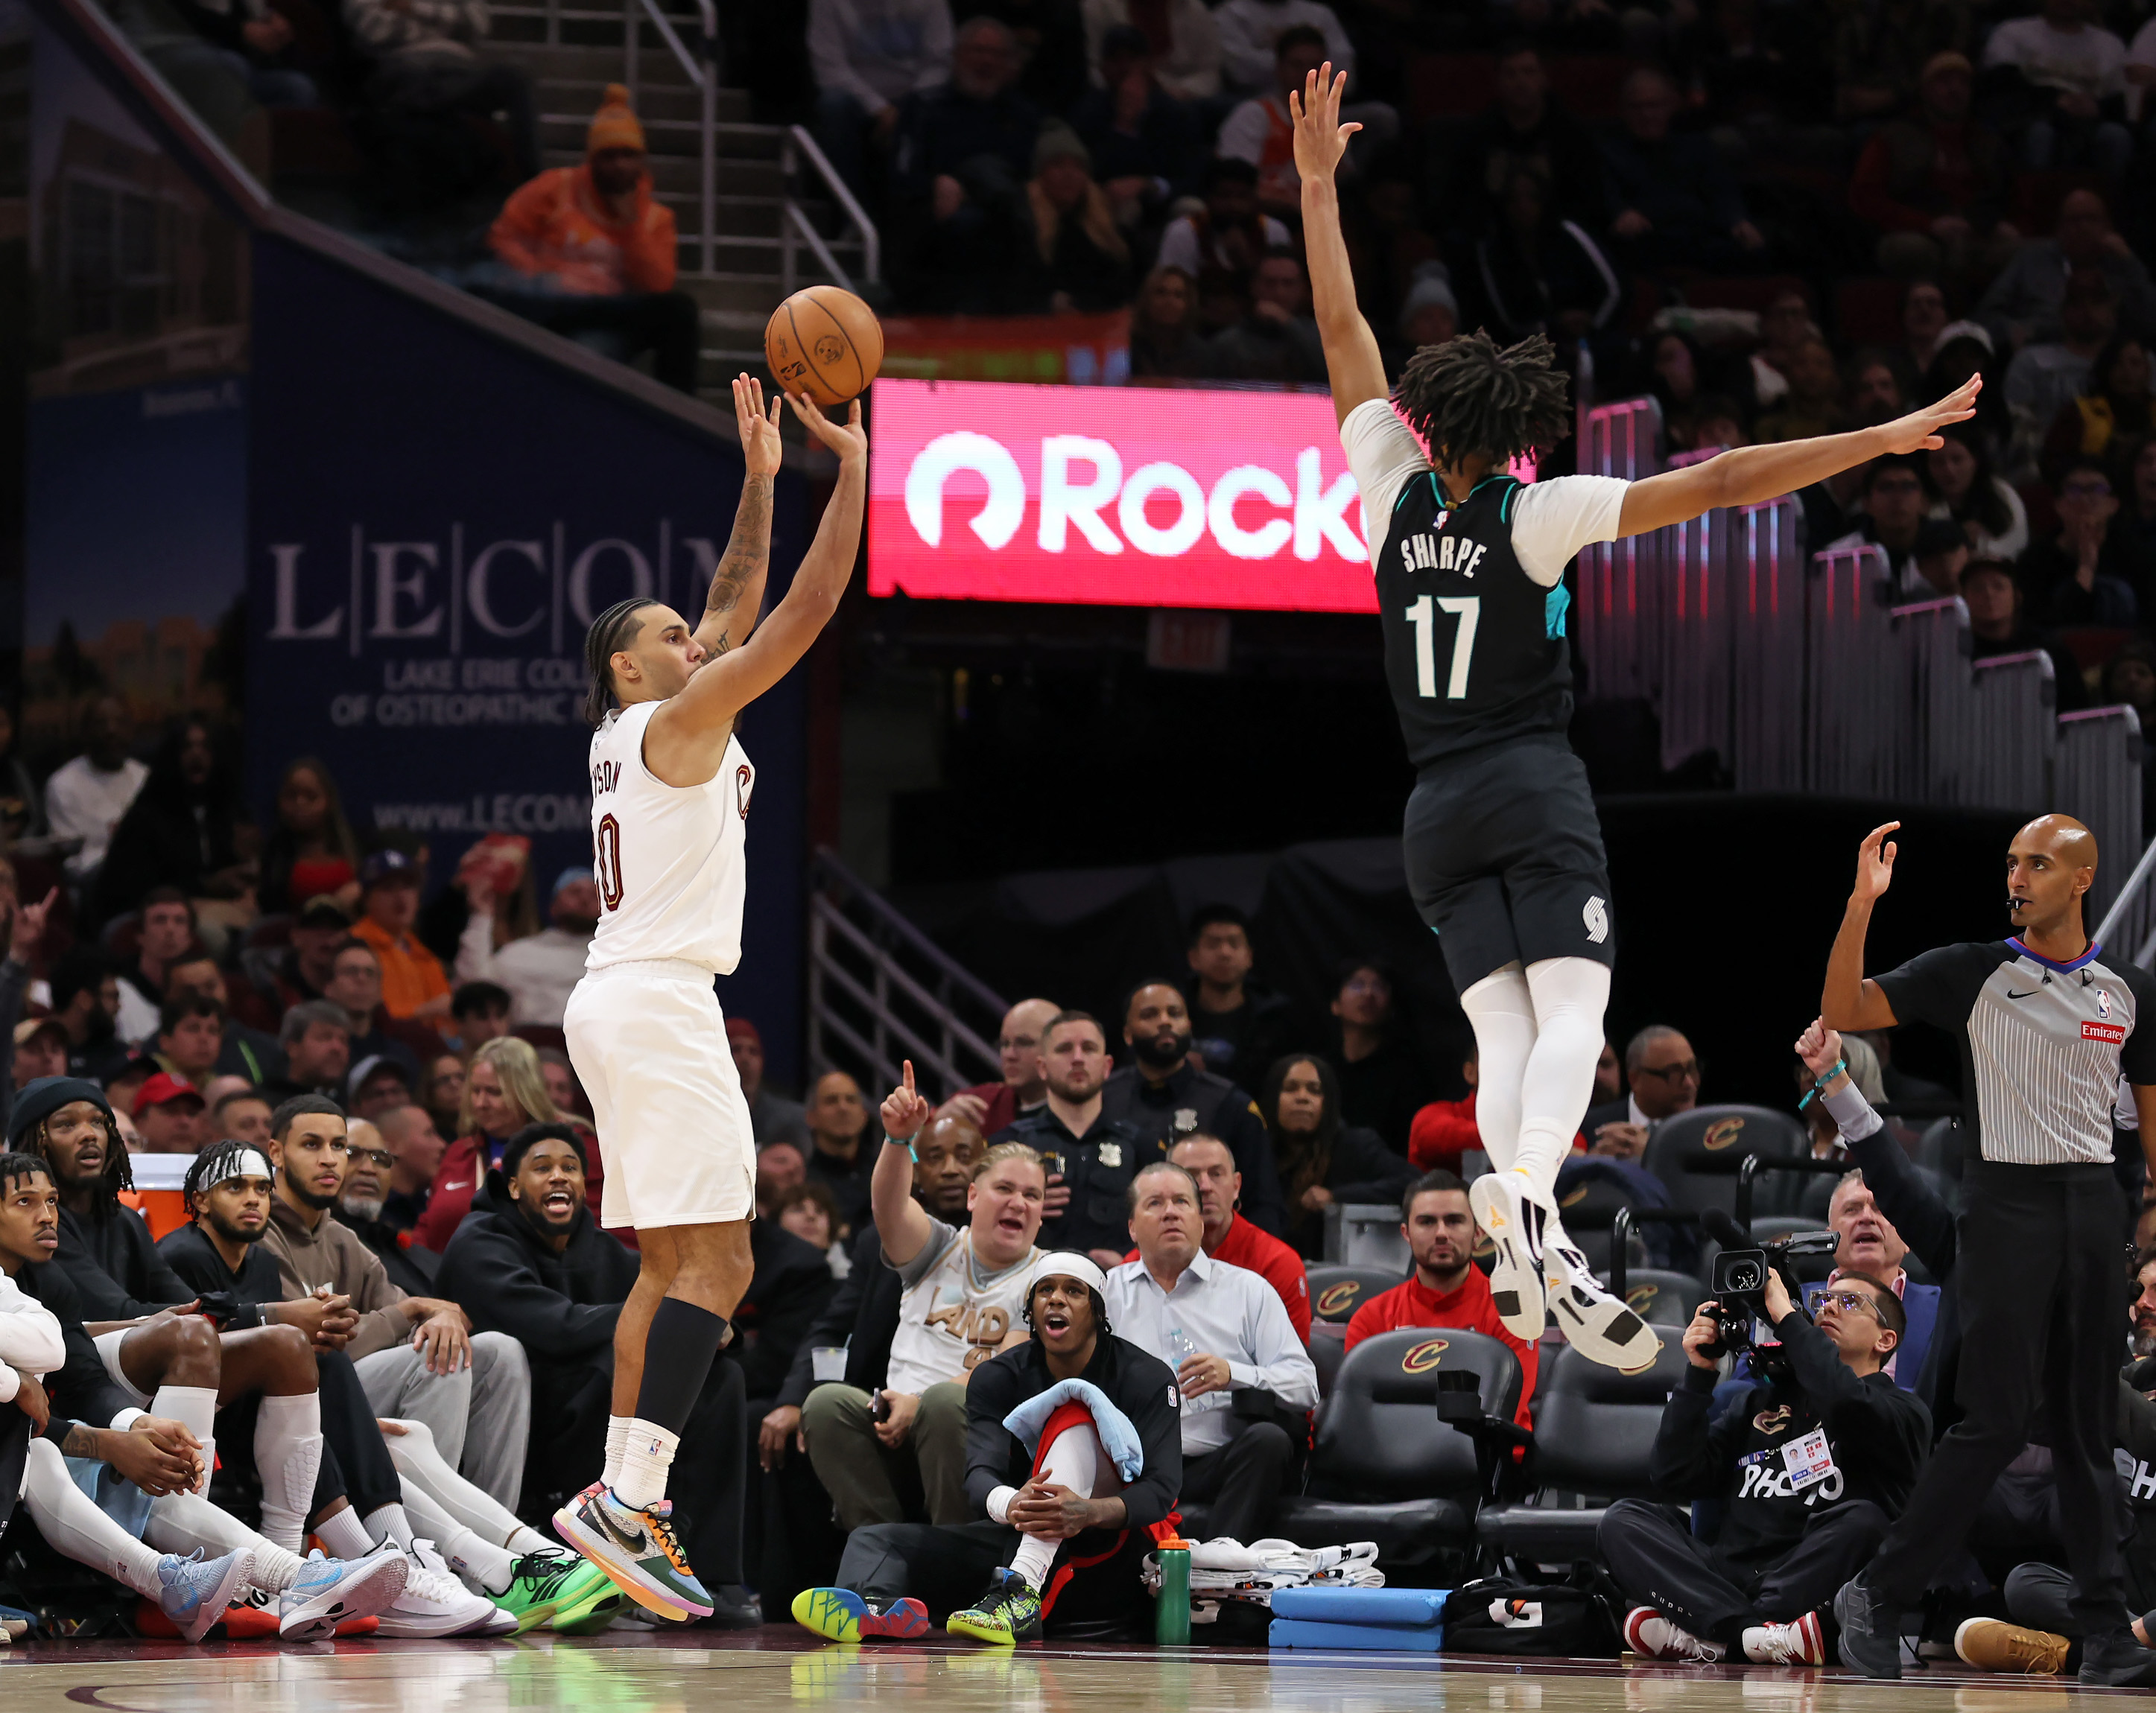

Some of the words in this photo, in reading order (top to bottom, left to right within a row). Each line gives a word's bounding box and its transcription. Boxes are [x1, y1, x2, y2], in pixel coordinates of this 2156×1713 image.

[1039, 434, 1369, 564] Rock
[1401, 533, 1488, 579] SHARPE
[1405, 594, 1480, 699] 17
[384, 661, 455, 691] LAKE
[462, 661, 520, 691] ERIE
[331, 696, 370, 727] OF
[377, 693, 568, 725] OSTEOPATHIC
[591, 760, 622, 798] YSON
[592, 812, 624, 917] 0
[2082, 1024, 2123, 1040] Emirates
[924, 1285, 1009, 1345] LAND
[1650, 1591, 1693, 1618] SUPR
